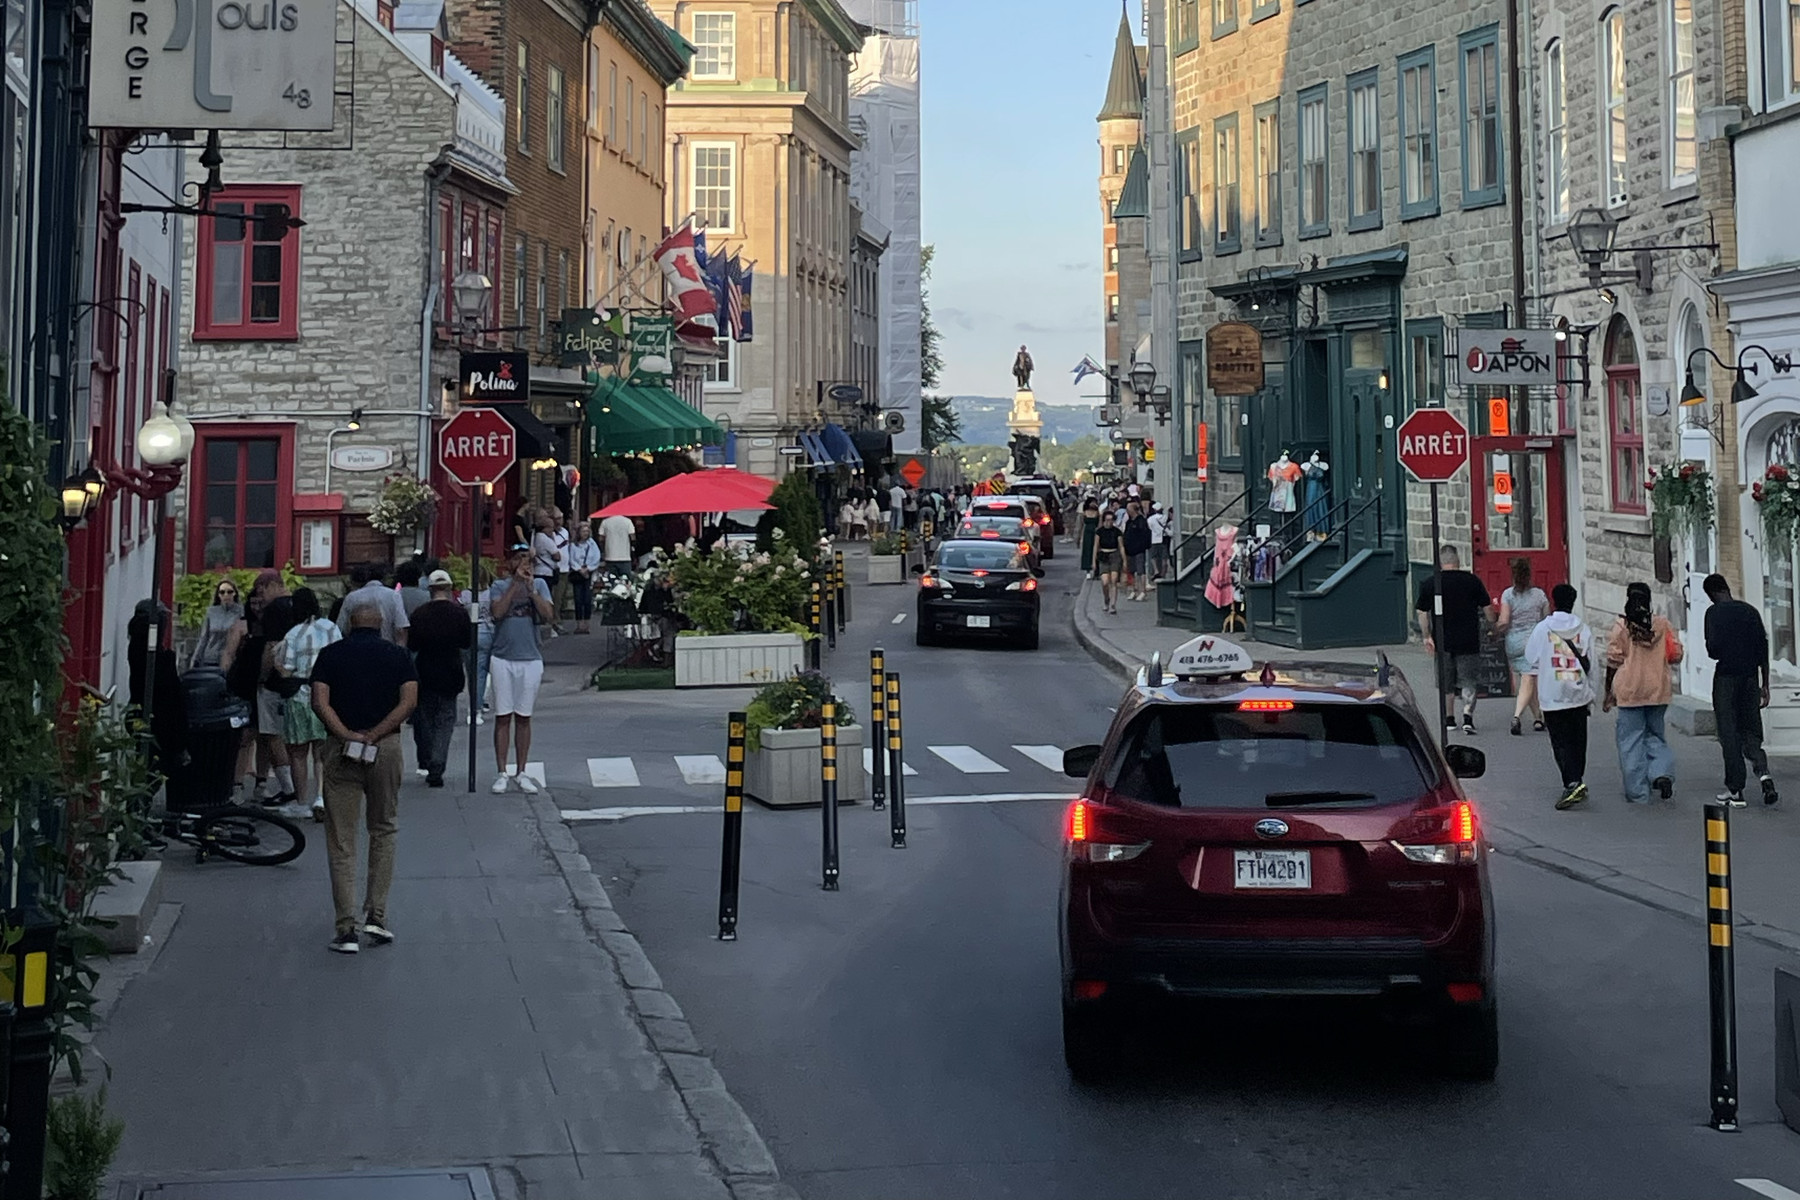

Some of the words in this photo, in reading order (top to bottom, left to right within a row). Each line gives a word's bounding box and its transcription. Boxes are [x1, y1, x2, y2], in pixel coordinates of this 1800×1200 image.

[282, 80, 313, 109] 48
[1472, 353, 1550, 373] JAPON
[469, 371, 519, 396] Polina
[444, 431, 511, 458] ARRÊT
[1402, 431, 1465, 456] ARRÊT
